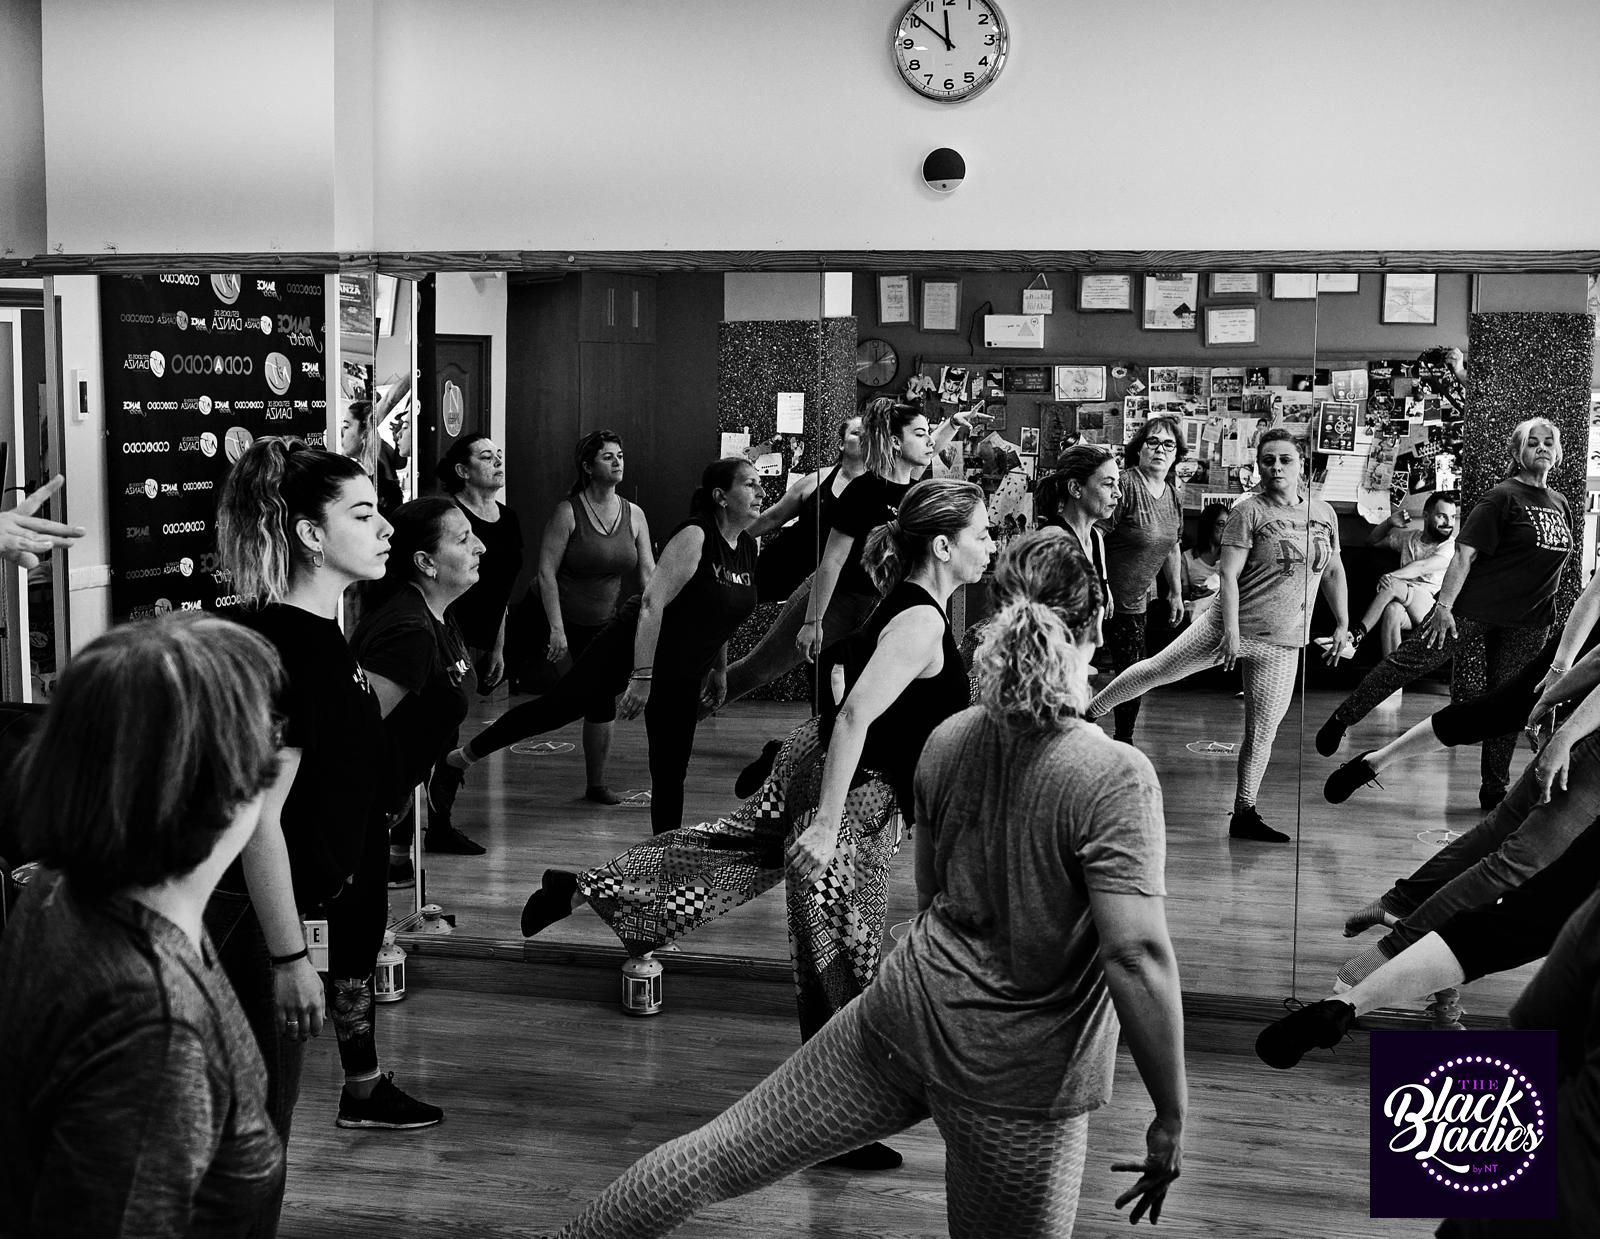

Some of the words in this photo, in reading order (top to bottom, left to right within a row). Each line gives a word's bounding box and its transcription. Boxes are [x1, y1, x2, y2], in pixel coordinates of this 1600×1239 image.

[926, 1, 933, 12] 11
[968, 0, 971, 10] 1
[911, 16, 920, 28] 10
[978, 14, 988, 25] 2
[904, 39, 913, 49] 9
[984, 35, 995, 45] 3
[909, 60, 920, 70] 8
[979, 56, 988, 66] 4
[924, 74, 933, 85] 7
[964, 72, 974, 83] 5
[944, 79, 954, 89] 6
[340, 284, 361, 295] ANZA
[313, 927, 320, 943] E
